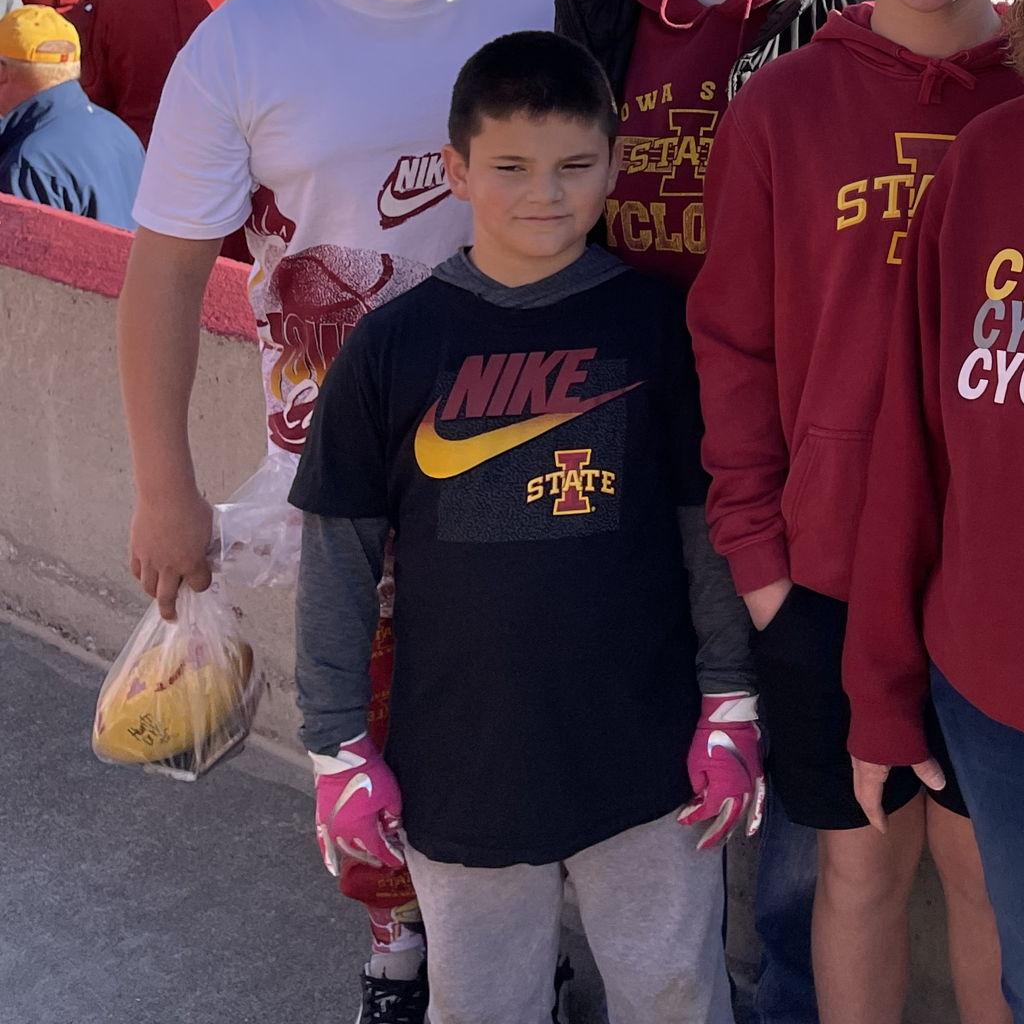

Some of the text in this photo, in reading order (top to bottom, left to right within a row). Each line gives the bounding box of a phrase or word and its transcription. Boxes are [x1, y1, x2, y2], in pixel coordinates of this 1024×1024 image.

[620, 82, 673, 122] OWA
[393, 153, 446, 193] NIK
[604, 199, 707, 255] YCLO
[440, 348, 598, 420] NIKE
[526, 469, 616, 504] STATE
